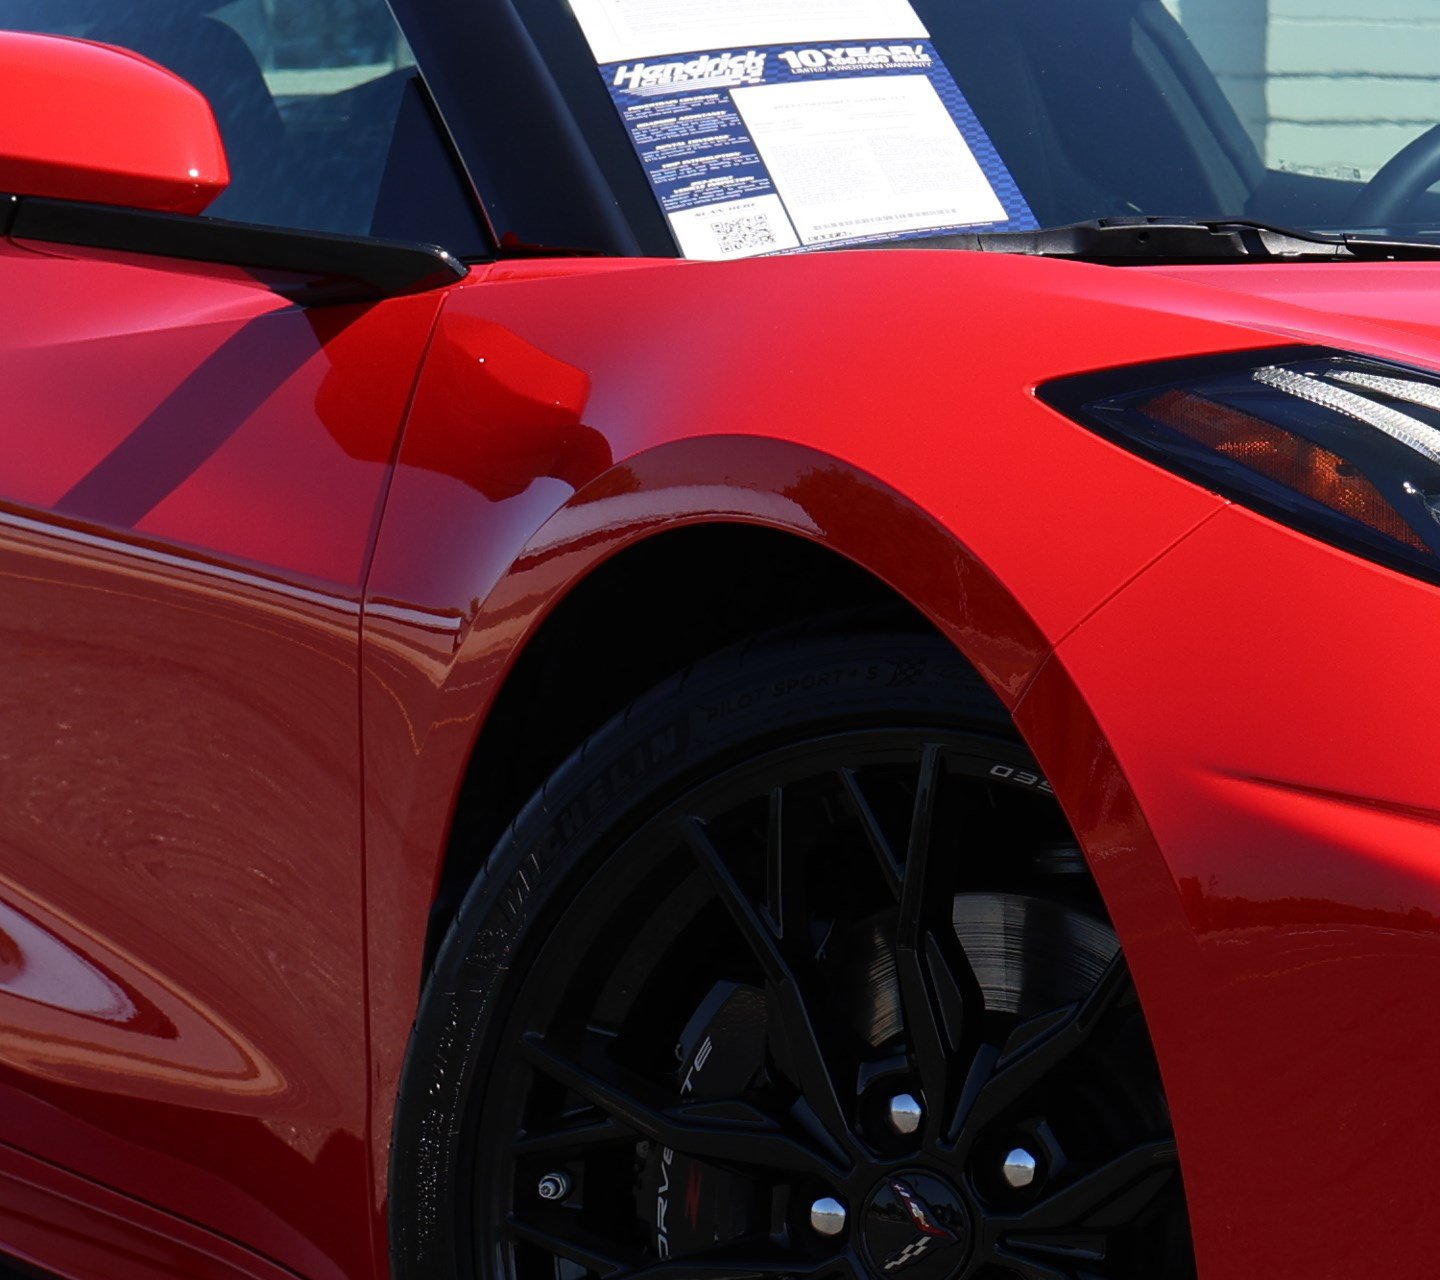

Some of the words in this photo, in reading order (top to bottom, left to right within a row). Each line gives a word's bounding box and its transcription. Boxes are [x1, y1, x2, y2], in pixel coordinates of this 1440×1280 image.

[778, 49, 827, 69] 10
[791, 66, 825, 74] LIMITED
[827, 63, 884, 73] POWERTRAIN
[885, 60, 932, 69] WARRANTY
[613, 50, 767, 89] Hendrick
